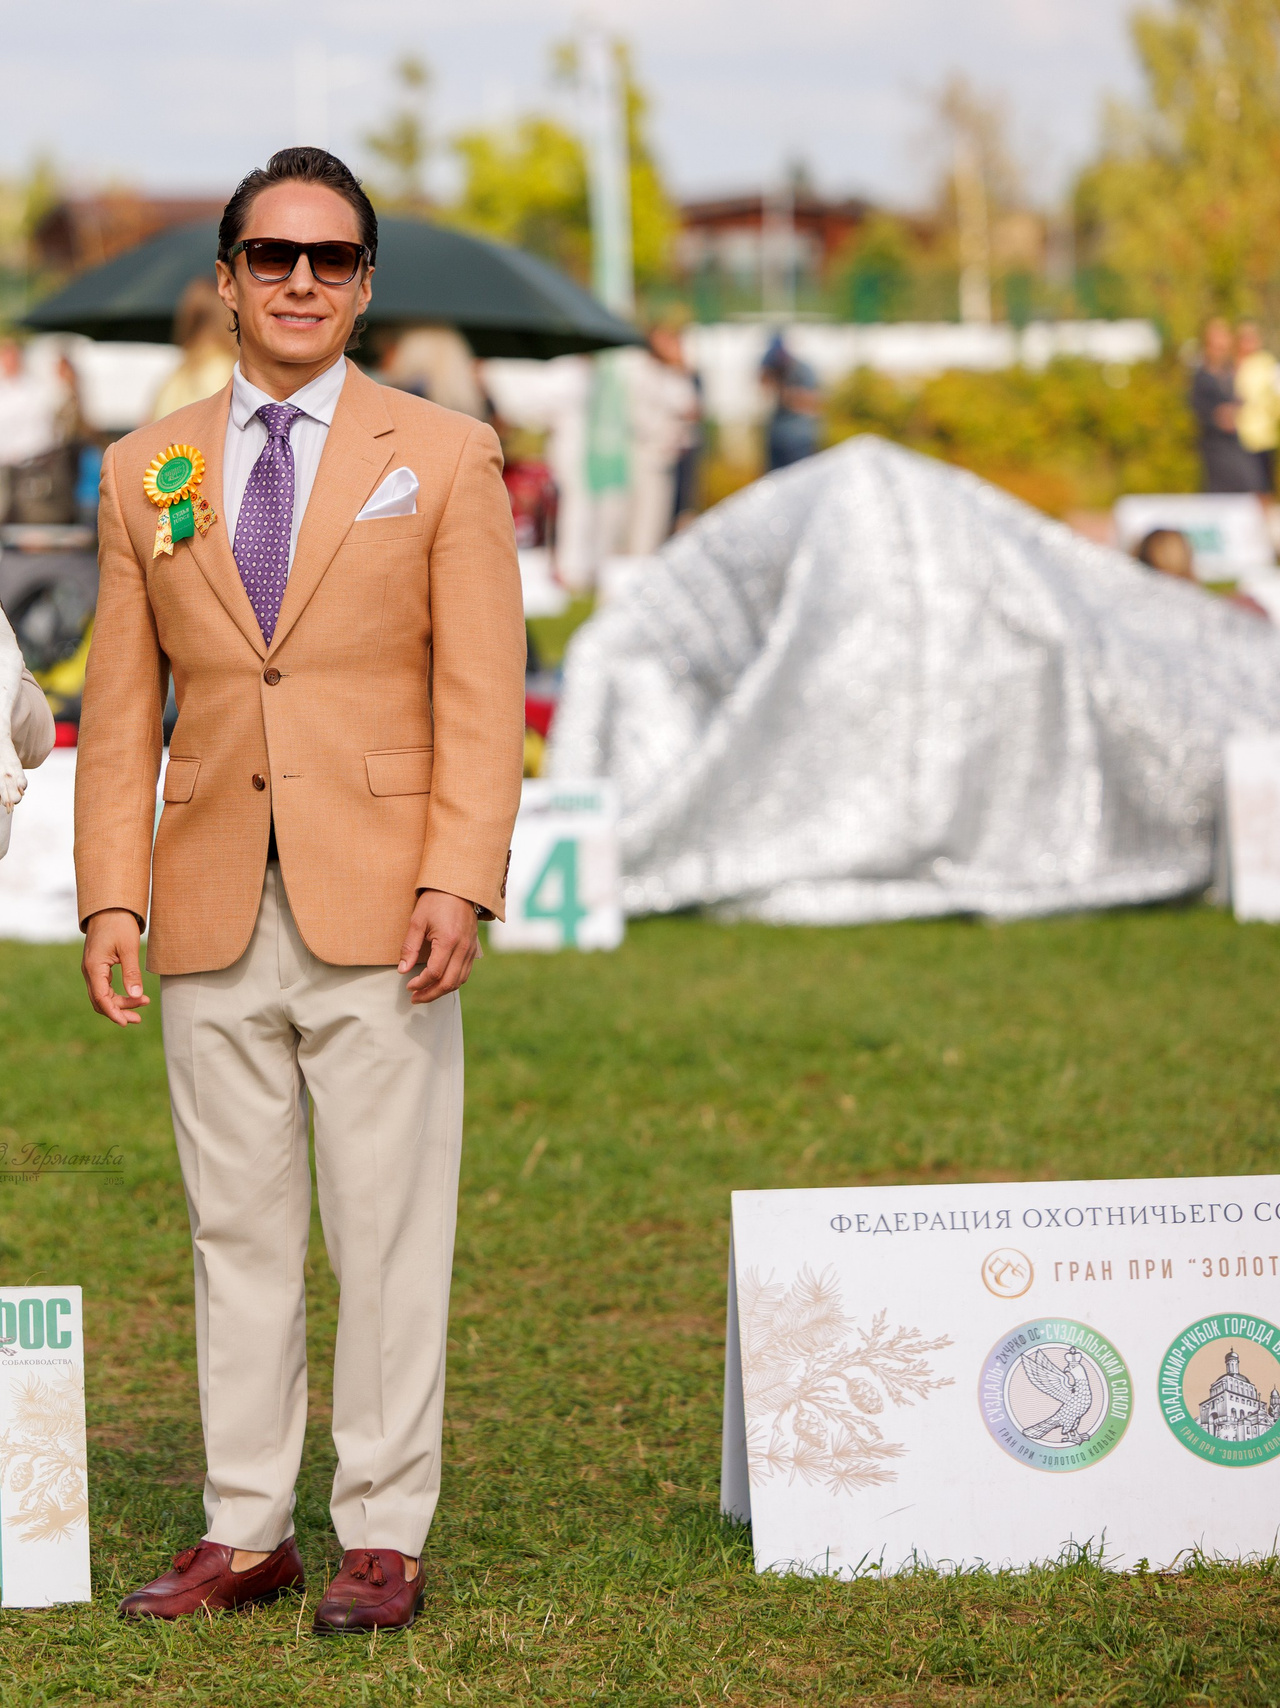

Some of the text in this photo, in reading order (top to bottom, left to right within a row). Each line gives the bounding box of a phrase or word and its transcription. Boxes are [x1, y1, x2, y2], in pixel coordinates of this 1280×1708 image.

[524, 837, 588, 947] 4
[830, 1201, 1280, 1236] ФЕДЕРАЦИЯ ОХОТНИЧЬЕГО С
[1054, 1260, 1113, 1282] ГРАН
[1129, 1259, 1173, 1280] ПРИ
[2, 1358, 73, 1366] СОБАКОВОДСТВА
[984, 1368, 1005, 1423] СУЗДАЛЬ
[1045, 1323, 1126, 1377] СУЗДАЛЬСКИЙ
[1111, 1379, 1129, 1419] СОКОЛ
[1162, 1349, 1186, 1424] ВЛАДИМИР
[1181, 1319, 1221, 1352] КУБОК
[1224, 1317, 1275, 1346] ГОРОДА
[998, 1428, 1018, 1448] ГРАН
[1019, 1444, 1035, 1460] ПРИ
[1180, 1426, 1199, 1446] ГРАН
[1199, 1441, 1216, 1455] ПРИ
